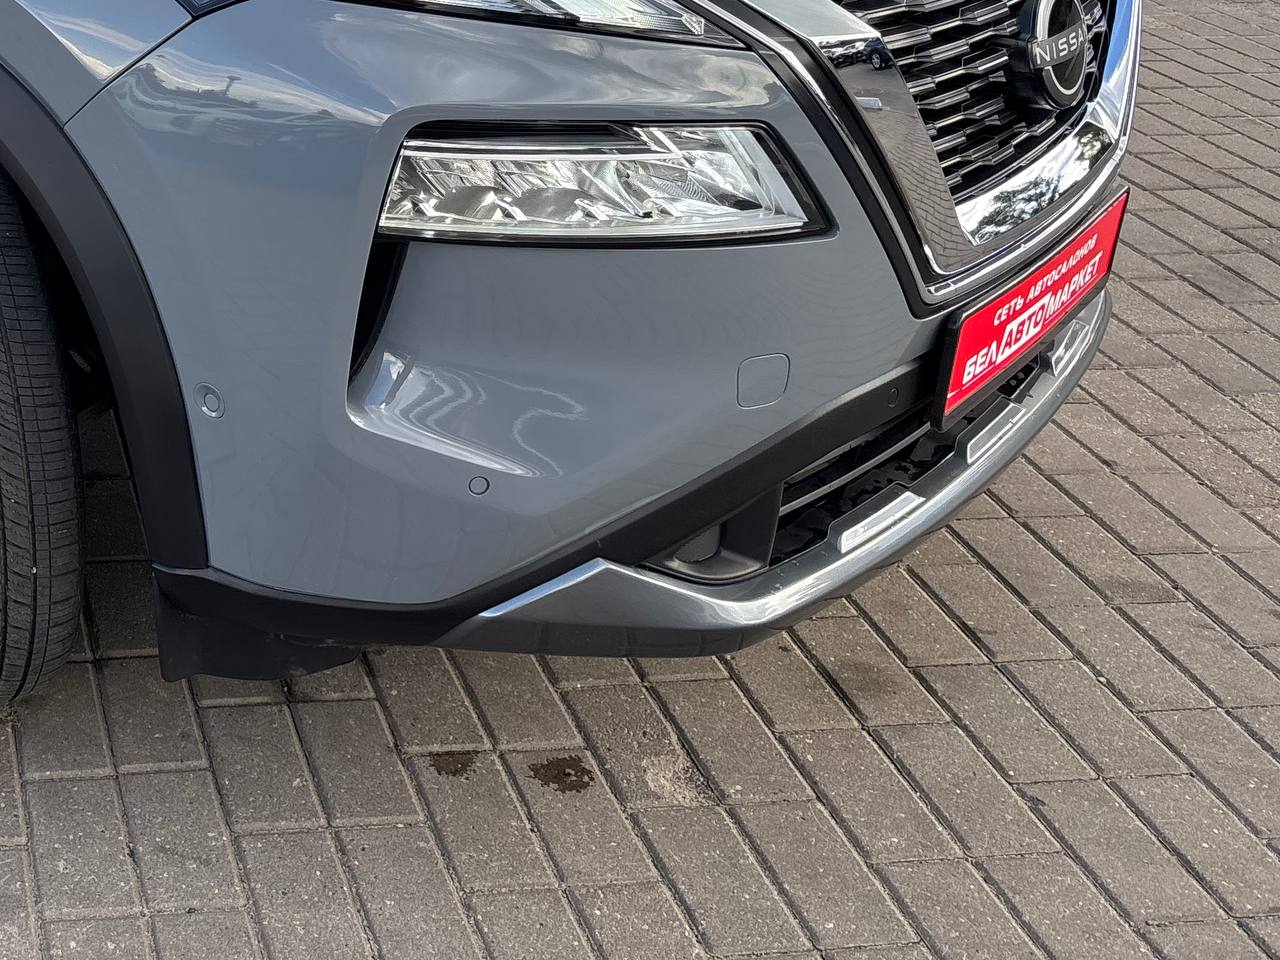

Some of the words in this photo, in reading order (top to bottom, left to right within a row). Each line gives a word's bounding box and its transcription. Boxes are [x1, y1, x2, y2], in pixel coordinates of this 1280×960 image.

[1035, 26, 1085, 65] NISSA
[993, 298, 1023, 327] СЕТЬ
[1026, 233, 1098, 304] АВТОСАЛОНОВ
